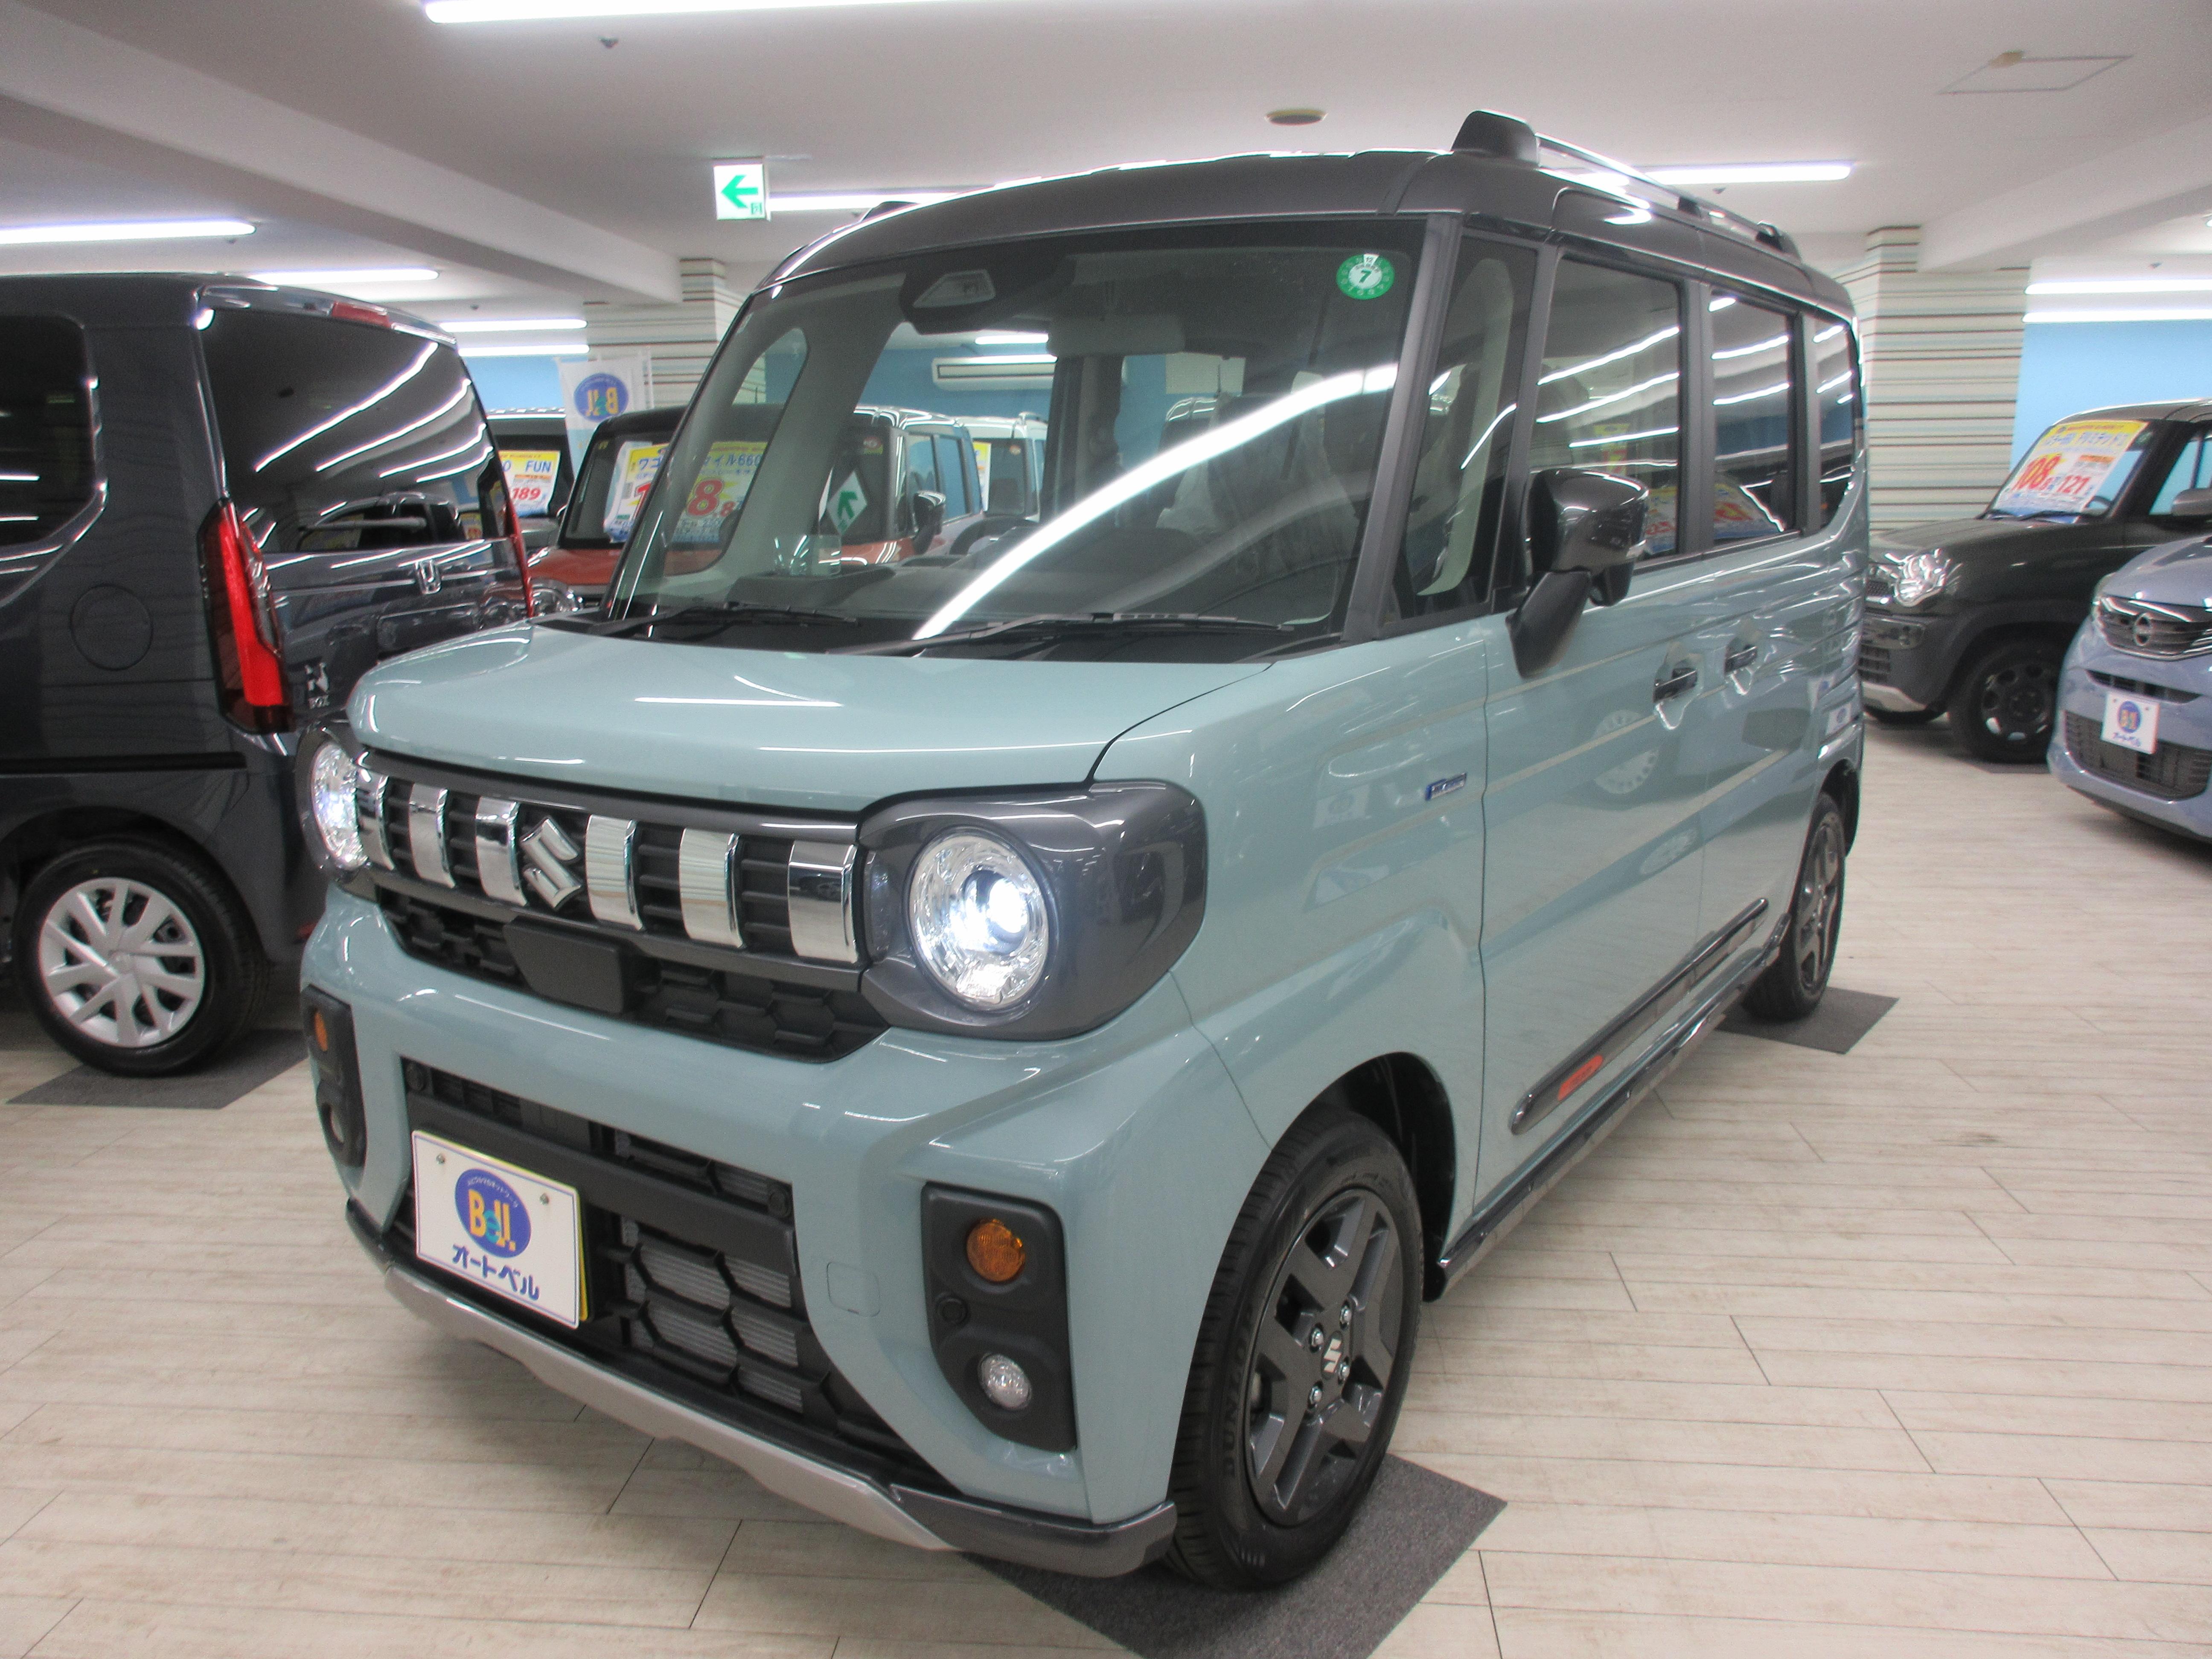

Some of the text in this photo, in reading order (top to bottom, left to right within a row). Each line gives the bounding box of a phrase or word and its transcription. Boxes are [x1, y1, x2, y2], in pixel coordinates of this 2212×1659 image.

[1359, 269, 1372, 284] 7
[525, 460, 552, 473] FUN
[512, 487, 541, 501] 189
[452, 1243, 541, 1301] オートベル
